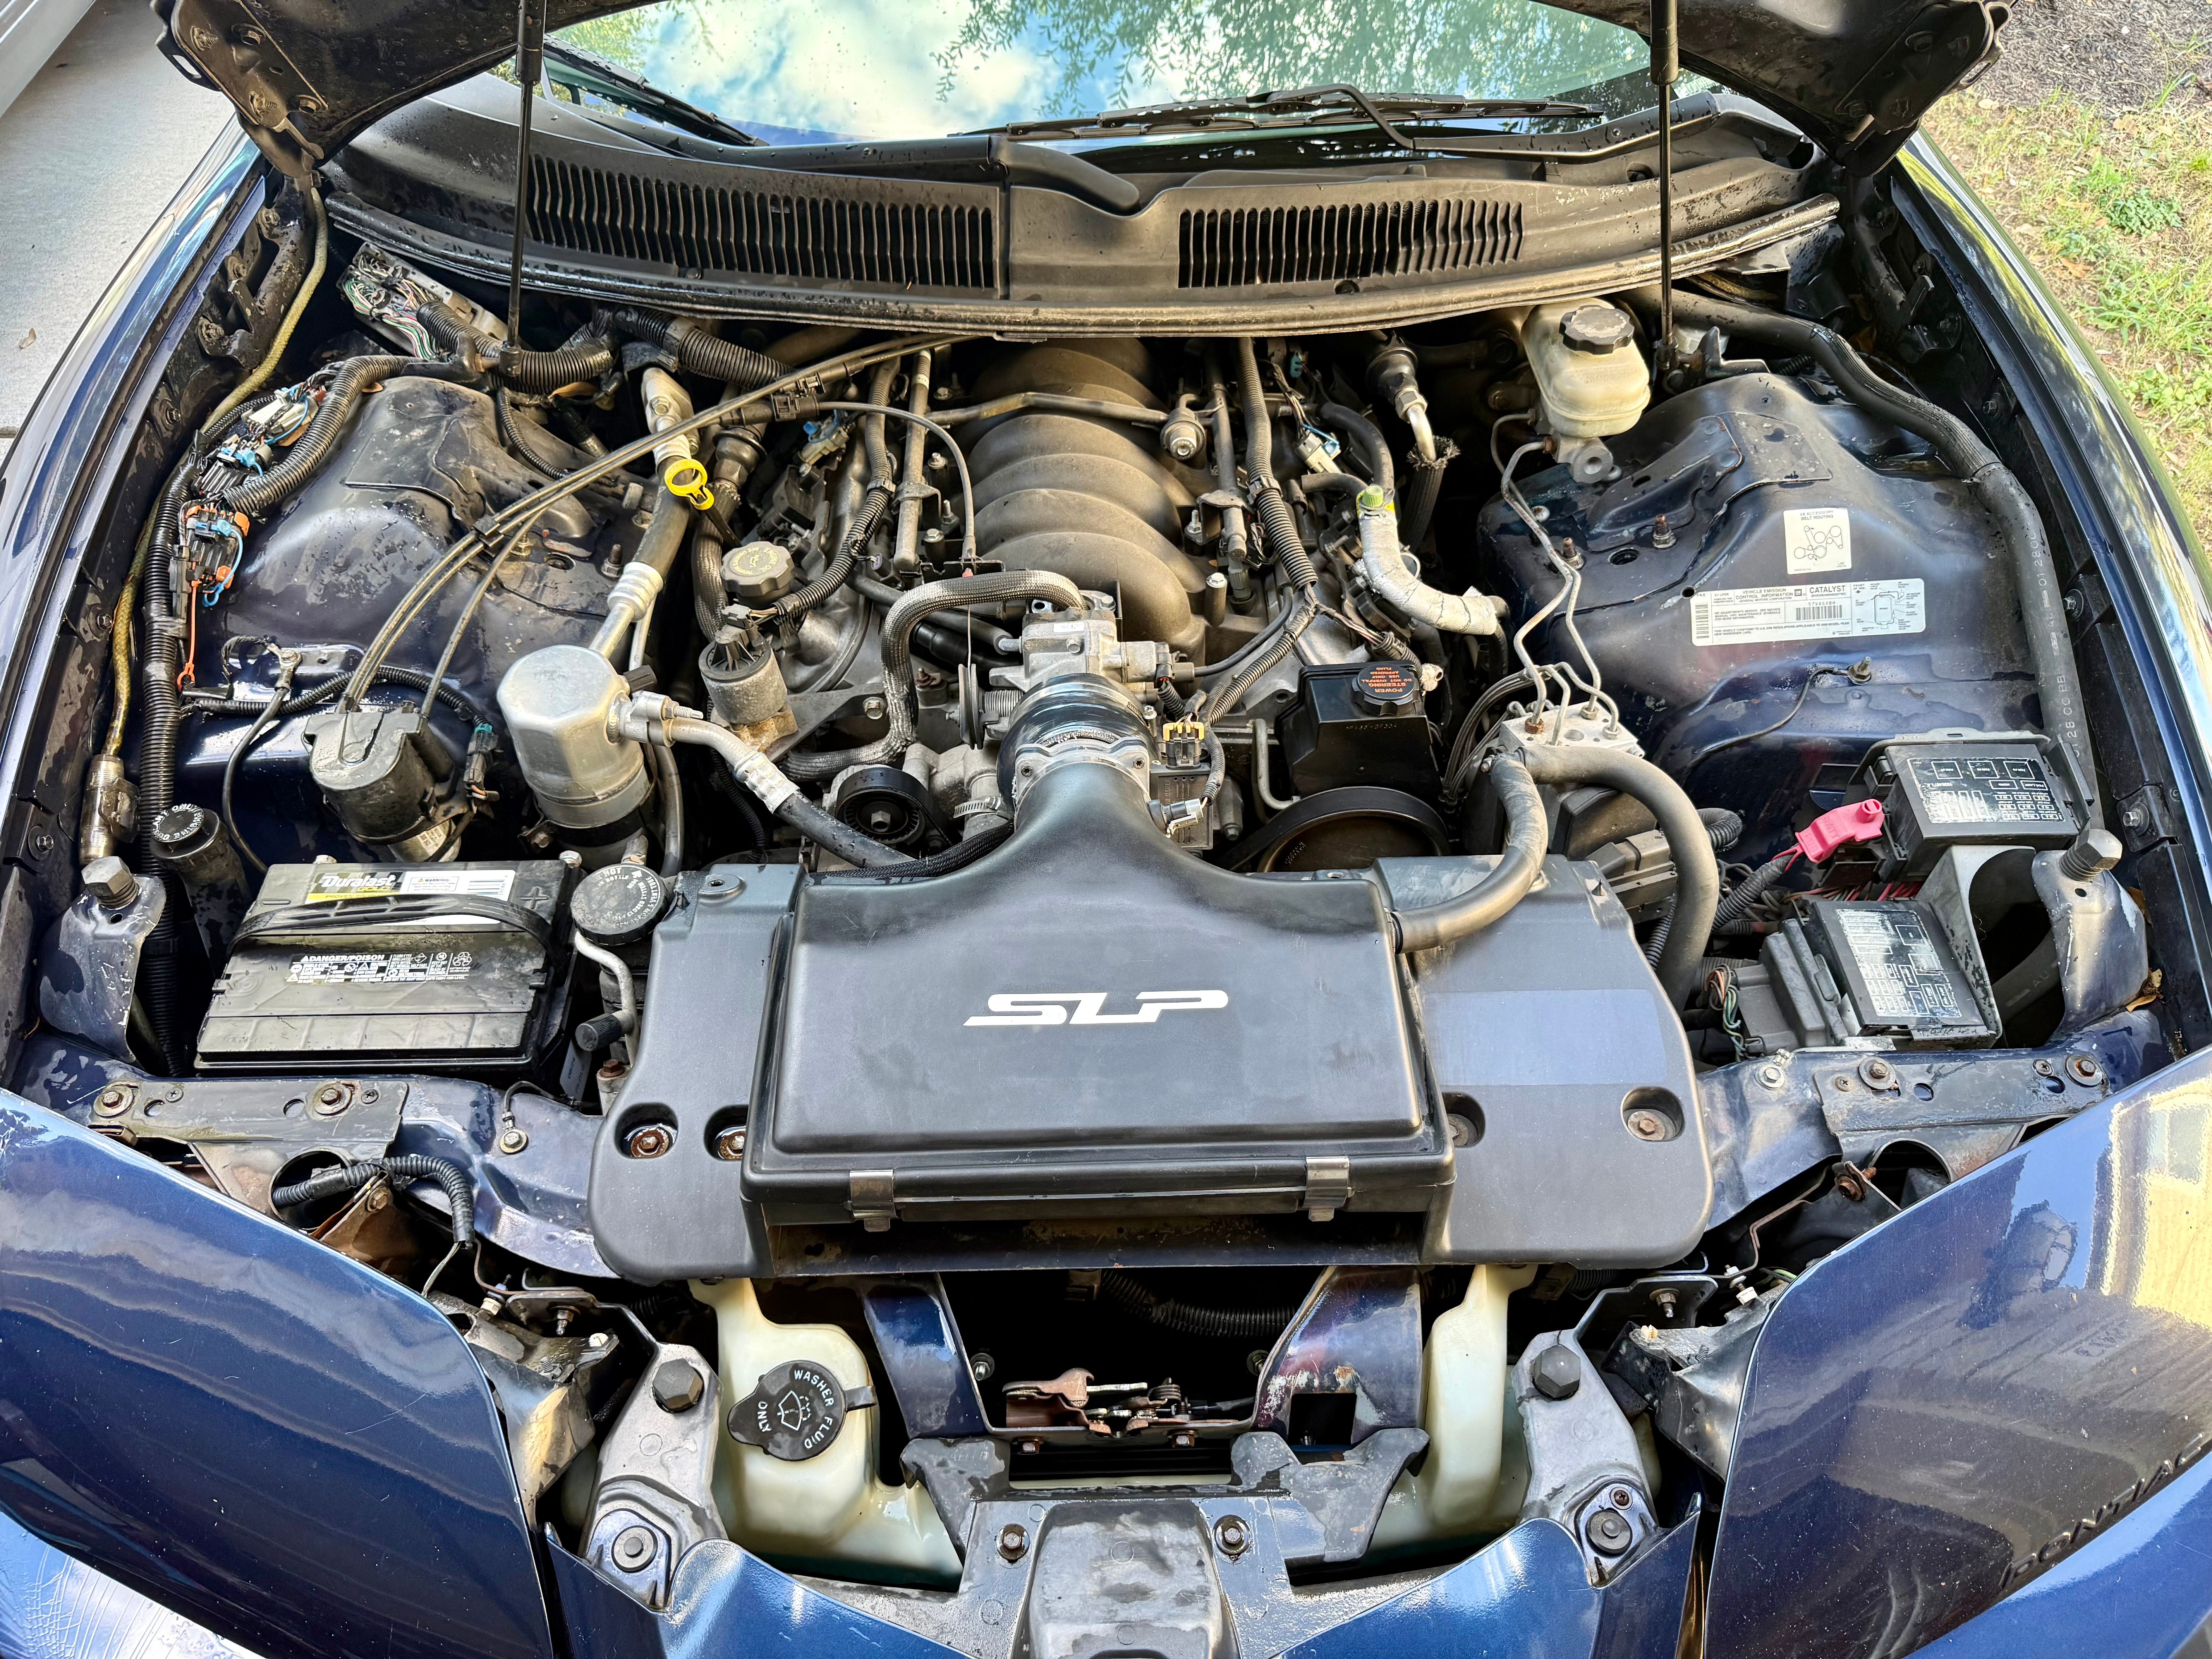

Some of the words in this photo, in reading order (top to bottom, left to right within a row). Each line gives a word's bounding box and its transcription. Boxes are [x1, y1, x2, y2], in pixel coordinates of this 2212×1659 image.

[763, 547, 778, 565] ENGINE
[733, 566, 754, 575] MANUAL
[2037, 573, 2047, 586] 01
[2057, 676, 2067, 692] BB
[2065, 721, 2076, 737] 28
[172, 803, 201, 812] ONLY
[152, 810, 170, 840] COOLANT
[174, 812, 204, 839] ENGINE
[321, 874, 396, 888] Duralast
[605, 875, 629, 883] BOTTLE
[646, 876, 657, 890] TUBE
[627, 900, 645, 917] CLOSED
[638, 881, 647, 900] SYSTEM
[649, 890, 658, 903] VENT
[963, 990, 1228, 1026] SLP
[794, 1370, 834, 1407] WASHER
[757, 1400, 772, 1432] ONLY
[805, 1417, 833, 1449] FLUID
[1998, 1432, 2204, 1589] PONTIAC
